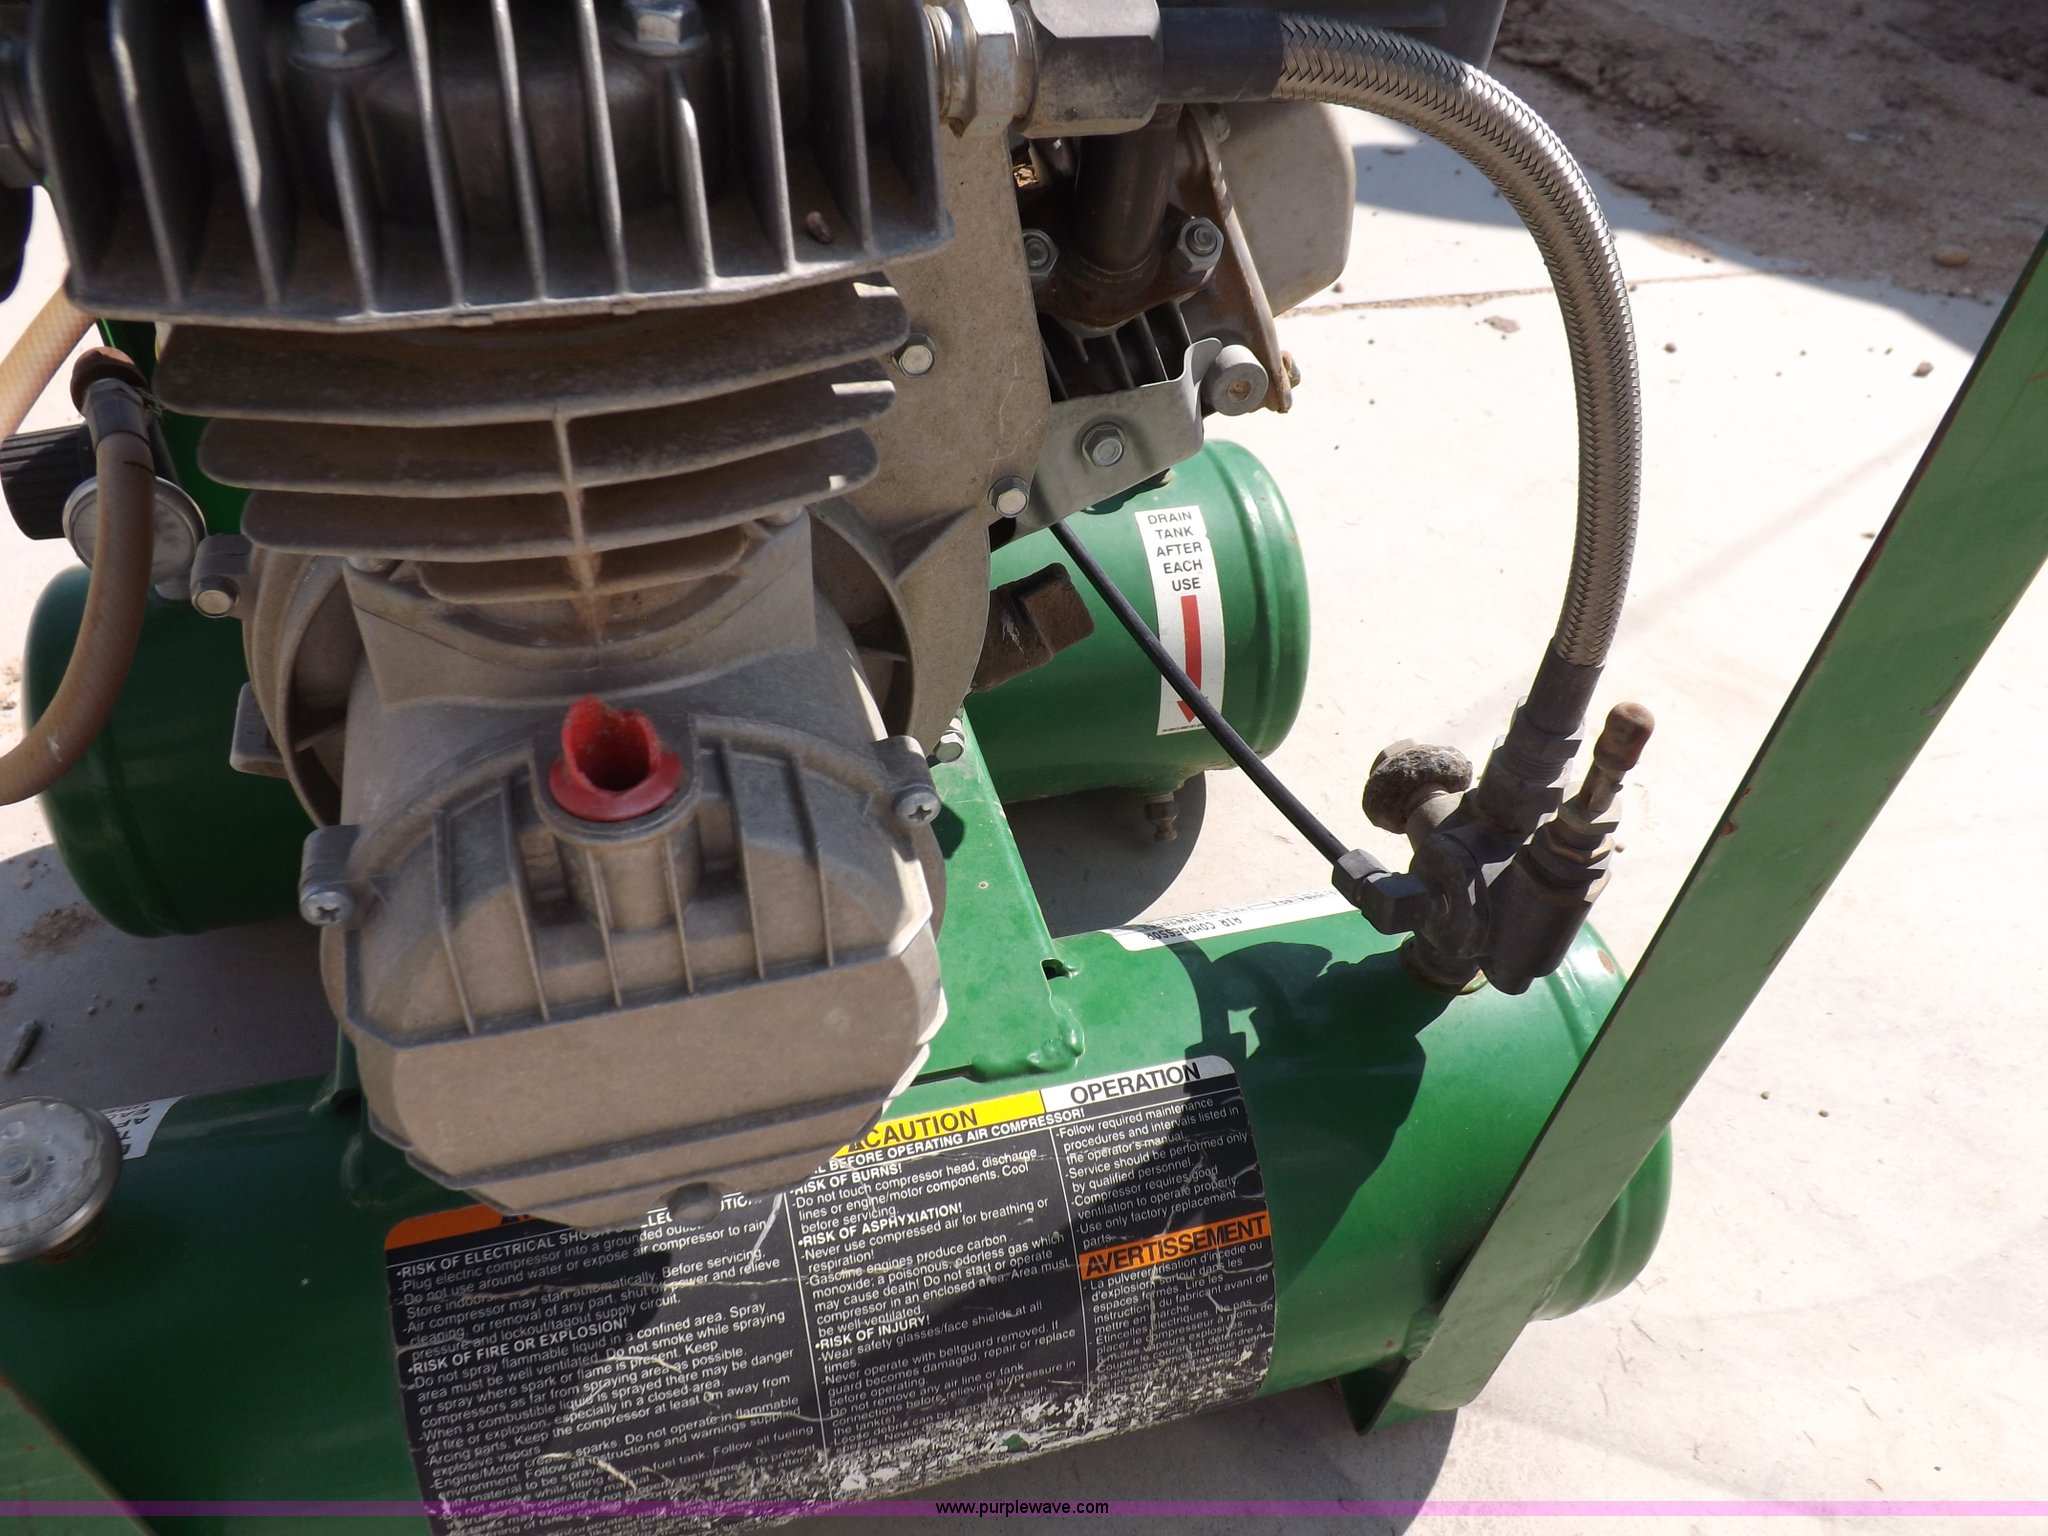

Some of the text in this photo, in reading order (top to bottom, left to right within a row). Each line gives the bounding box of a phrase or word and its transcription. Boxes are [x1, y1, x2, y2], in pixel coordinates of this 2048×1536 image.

[1148, 511, 1192, 525] DRAIN
[1155, 526, 1194, 539] TANK
[1157, 541, 1202, 557] AFTER
[1163, 559, 1203, 574] EACH
[1172, 577, 1201, 591] USE
[1147, 921, 1216, 940] COMPRESSOR
[1069, 1061, 1200, 1105] OPERATION
[863, 1107, 977, 1149] CAUTION
[1063, 1107, 1226, 1153] procedures and intervals listed
[1097, 1111, 1143, 1132] required
[1145, 1096, 1213, 1119] maintenance
[829, 1149, 883, 1170] BEFORE
[886, 1133, 962, 1159] OPERATING
[965, 1127, 988, 1142] AIR
[1066, 1140, 1140, 1164] the operator's
[1113, 1151, 1150, 1169] should
[1169, 1135, 1224, 1159] performed
[1226, 1129, 1248, 1146] only
[798, 1205, 827, 1220] lines
[845, 1185, 923, 1213] engine/motor
[1001, 1162, 1029, 1176] Cool
[816, 1190, 836, 1203] not
[839, 1182, 871, 1198] touch
[875, 1170, 944, 1193] compressor
[981, 1147, 1037, 1170] discharge
[829, 1174, 848, 1187] OF
[1088, 1170, 1135, 1190] qualified
[1144, 1172, 1188, 1193] requires
[1191, 1165, 1218, 1182] good
[1077, 1186, 1191, 1219] ventilation operate
[1105, 1188, 1237, 1230] only factory replacement
[801, 1217, 839, 1234] before
[838, 1225, 857, 1239] OF
[844, 1240, 866, 1252] use
[868, 1220, 941, 1248] compressed
[943, 1216, 959, 1229] air
[962, 1212, 978, 1225] for
[980, 1200, 1034, 1224] breathing
[435, 1265, 482, 1284] electric
[485, 1251, 561, 1276] compressor
[564, 1243, 587, 1257] into
[603, 1227, 663, 1251] grounded
[440, 1256, 460, 1269] OF
[463, 1236, 554, 1264] ELECTRICAL
[478, 1230, 726, 1289] around water expose air compressor
[865, 1233, 1007, 1276] engines produce carbon
[1007, 1243, 1029, 1256] gas
[1085, 1215, 1268, 1275] AVERTISSEMENT
[429, 1259, 703, 1330] compressor may Before
[814, 1299, 840, 1314] may
[843, 1290, 879, 1305] cause
[923, 1274, 940, 1287] Do
[943, 1269, 961, 1281] not
[965, 1263, 991, 1277] start
[1009, 1249, 1053, 1270] operate
[816, 1301, 887, 1327] compressor
[922, 1279, 975, 1300] enclosed
[1010, 1265, 1037, 1279] Area
[1040, 1258, 1069, 1272] must
[1092, 1273, 1223, 1314] espaces Lire les
[1223, 1276, 1253, 1291] avant
[595, 1303, 636, 1322] supply
[1094, 1317, 1129, 1334] mettre
[486, 1311, 786, 1386] be well not smoke while spraying
[502, 1301, 767, 1369] flammable liquid confined Spray
[684, 1339, 718, 1357] Keep
[855, 1327, 875, 1341] OF
[856, 1336, 893, 1355] safety
[451, 1352, 472, 1365] OF
[476, 1343, 510, 1360] FIRE
[513, 1338, 535, 1352] OR
[827, 1327, 1076, 1397] guard becomes repair replace
[863, 1336, 993, 1378] operate with beltguard
[611, 1348, 794, 1400] sprayed may be danger
[552, 1425, 573, 1438] the
[576, 1407, 651, 1433] compressor
[726, 1383, 759, 1399] away
[762, 1374, 790, 1388] from
[828, 1390, 866, 1406] before
[873, 1379, 959, 1406] remove any air
[690, 1420, 746, 1442] warnings
